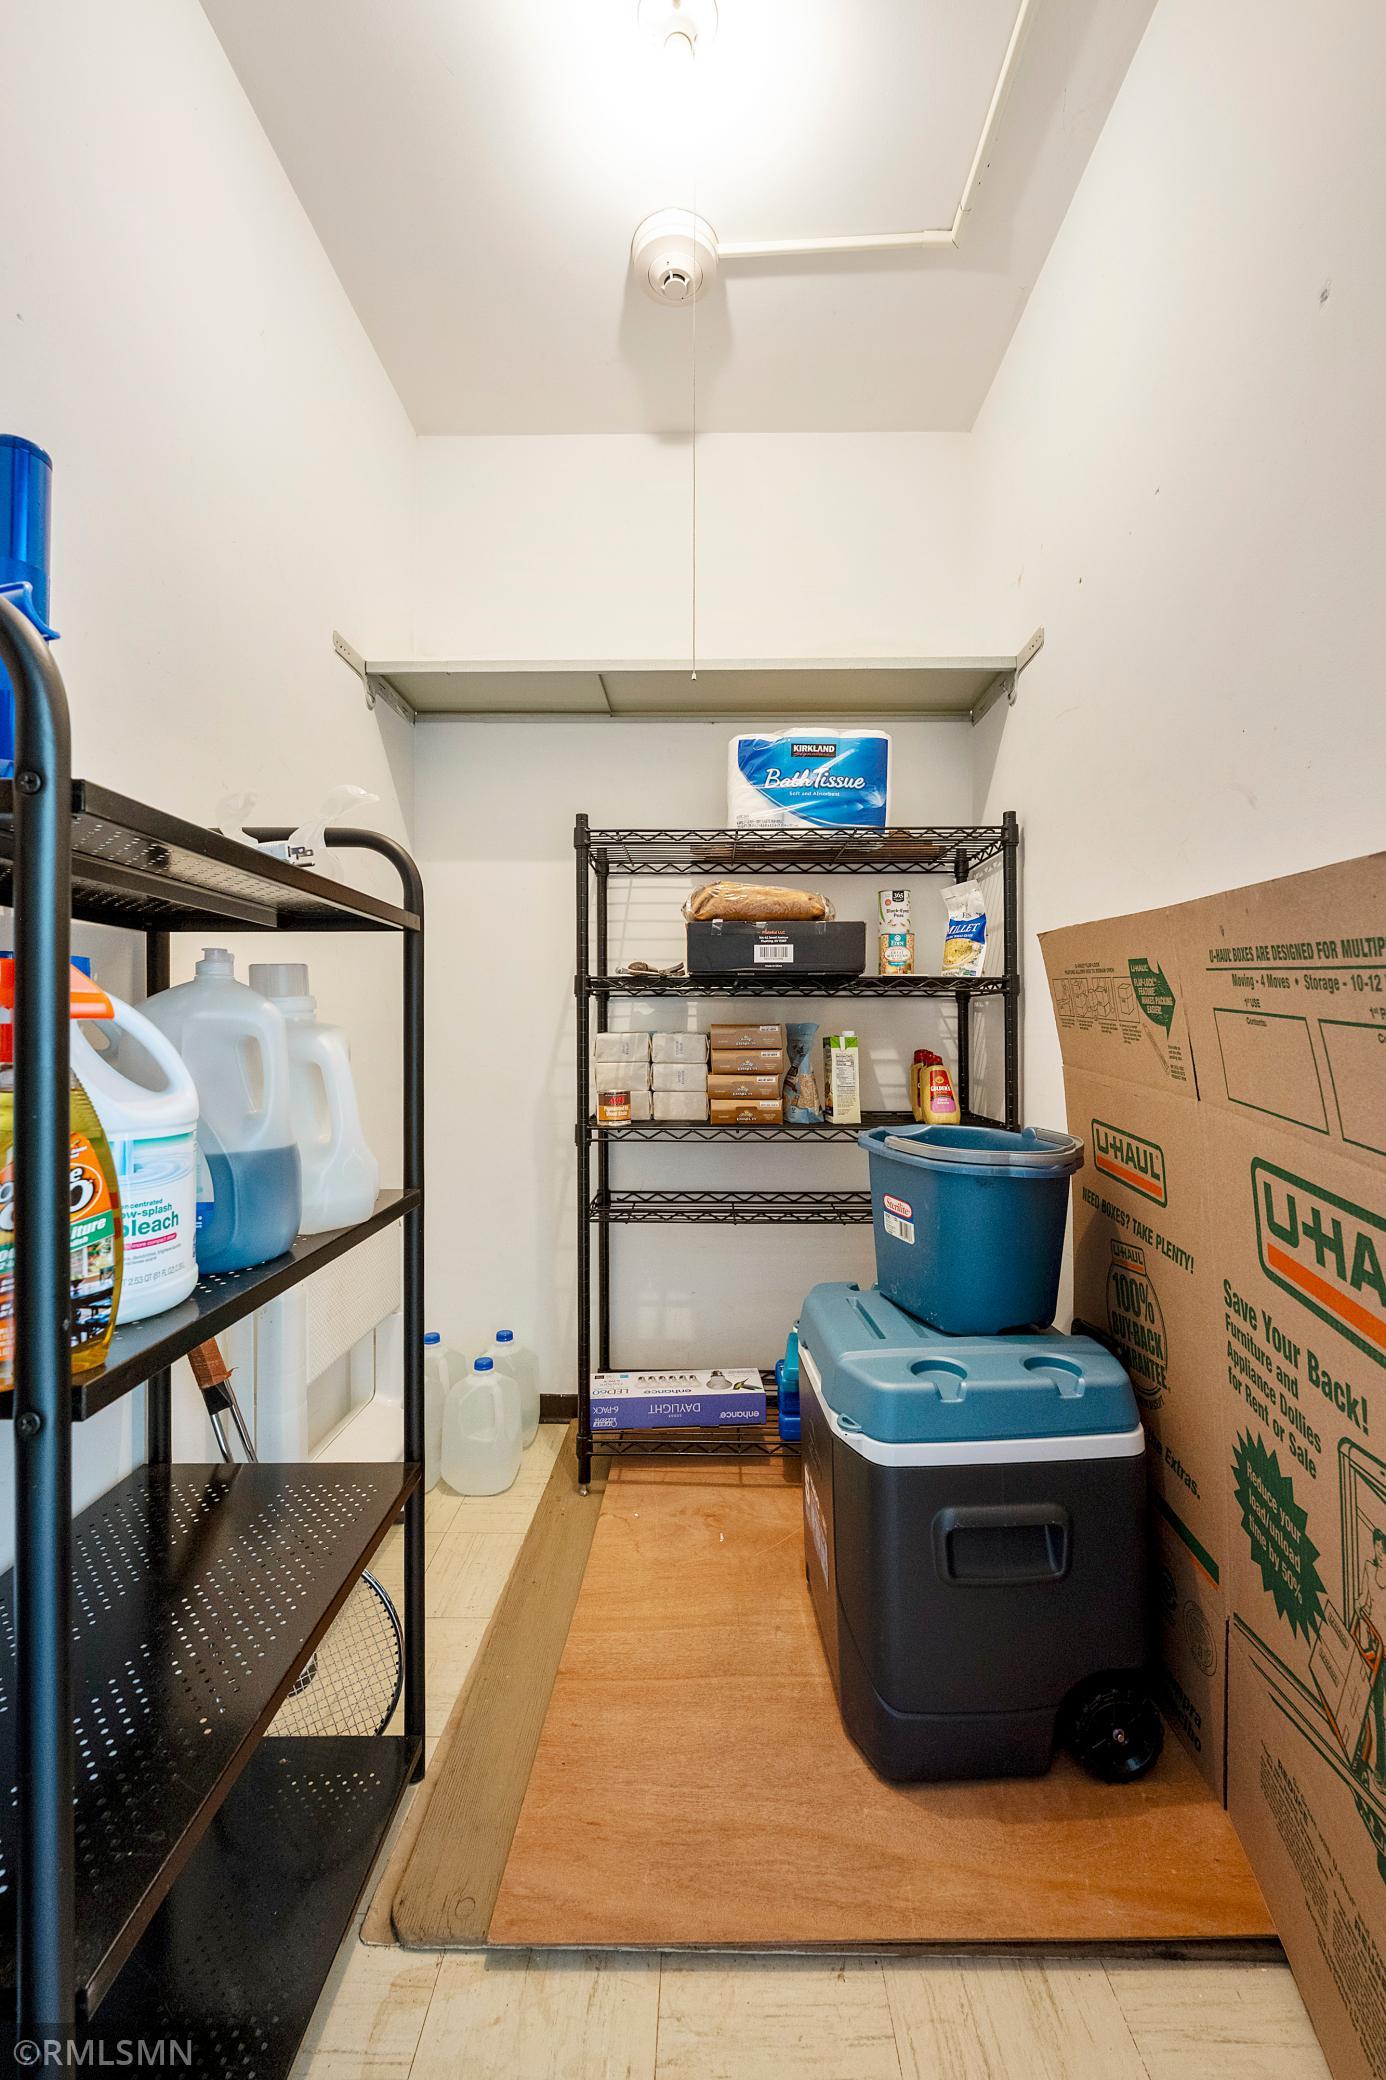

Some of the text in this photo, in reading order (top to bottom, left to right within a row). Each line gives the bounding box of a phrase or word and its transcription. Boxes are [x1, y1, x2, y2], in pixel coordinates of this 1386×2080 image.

[793, 745, 835, 753] KIRKLAND
[764, 767, 865, 789] Bath Tissue
[1232, 947, 1254, 962] BOXES
[1256, 945, 1270, 961] ARE
[1271, 943, 1314, 961] DESIGNED
[1316, 940, 1338, 960] FOR
[1340, 936, 1386, 958] MULTIP
[1232, 974, 1254, 990] Moving
[1261, 975, 1265, 988] 4
[1267, 974, 1290, 989] Moves
[1303, 975, 1340, 994] Storage
[1350, 974, 1383, 992] 10-12
[122, 1202, 172, 1220] ow-splash
[1082, 1187, 1195, 1274] NEED BOXES? TAKE PLENTY!
[1112, 1272, 1155, 1325] 100%
[1112, 1311, 1164, 1361] BUY-BACK
[1223, 1278, 1369, 1437] Save Your Back!
[1225, 1312, 1299, 1400] Furniture and
[593, 1406, 619, 1414] 6-PACK
[648, 1403, 700, 1415] DAYLIGHT
[1227, 1340, 1322, 1454] Appliance Dollies
[1228, 1366, 1317, 1480] for Rent or Sale
[1165, 1446, 1200, 1500] Extras.
[1246, 1460, 1301, 1544] Reduce your
[1249, 1487, 1301, 1574] load/unload
[1249, 1513, 1303, 1605] time by 50%
